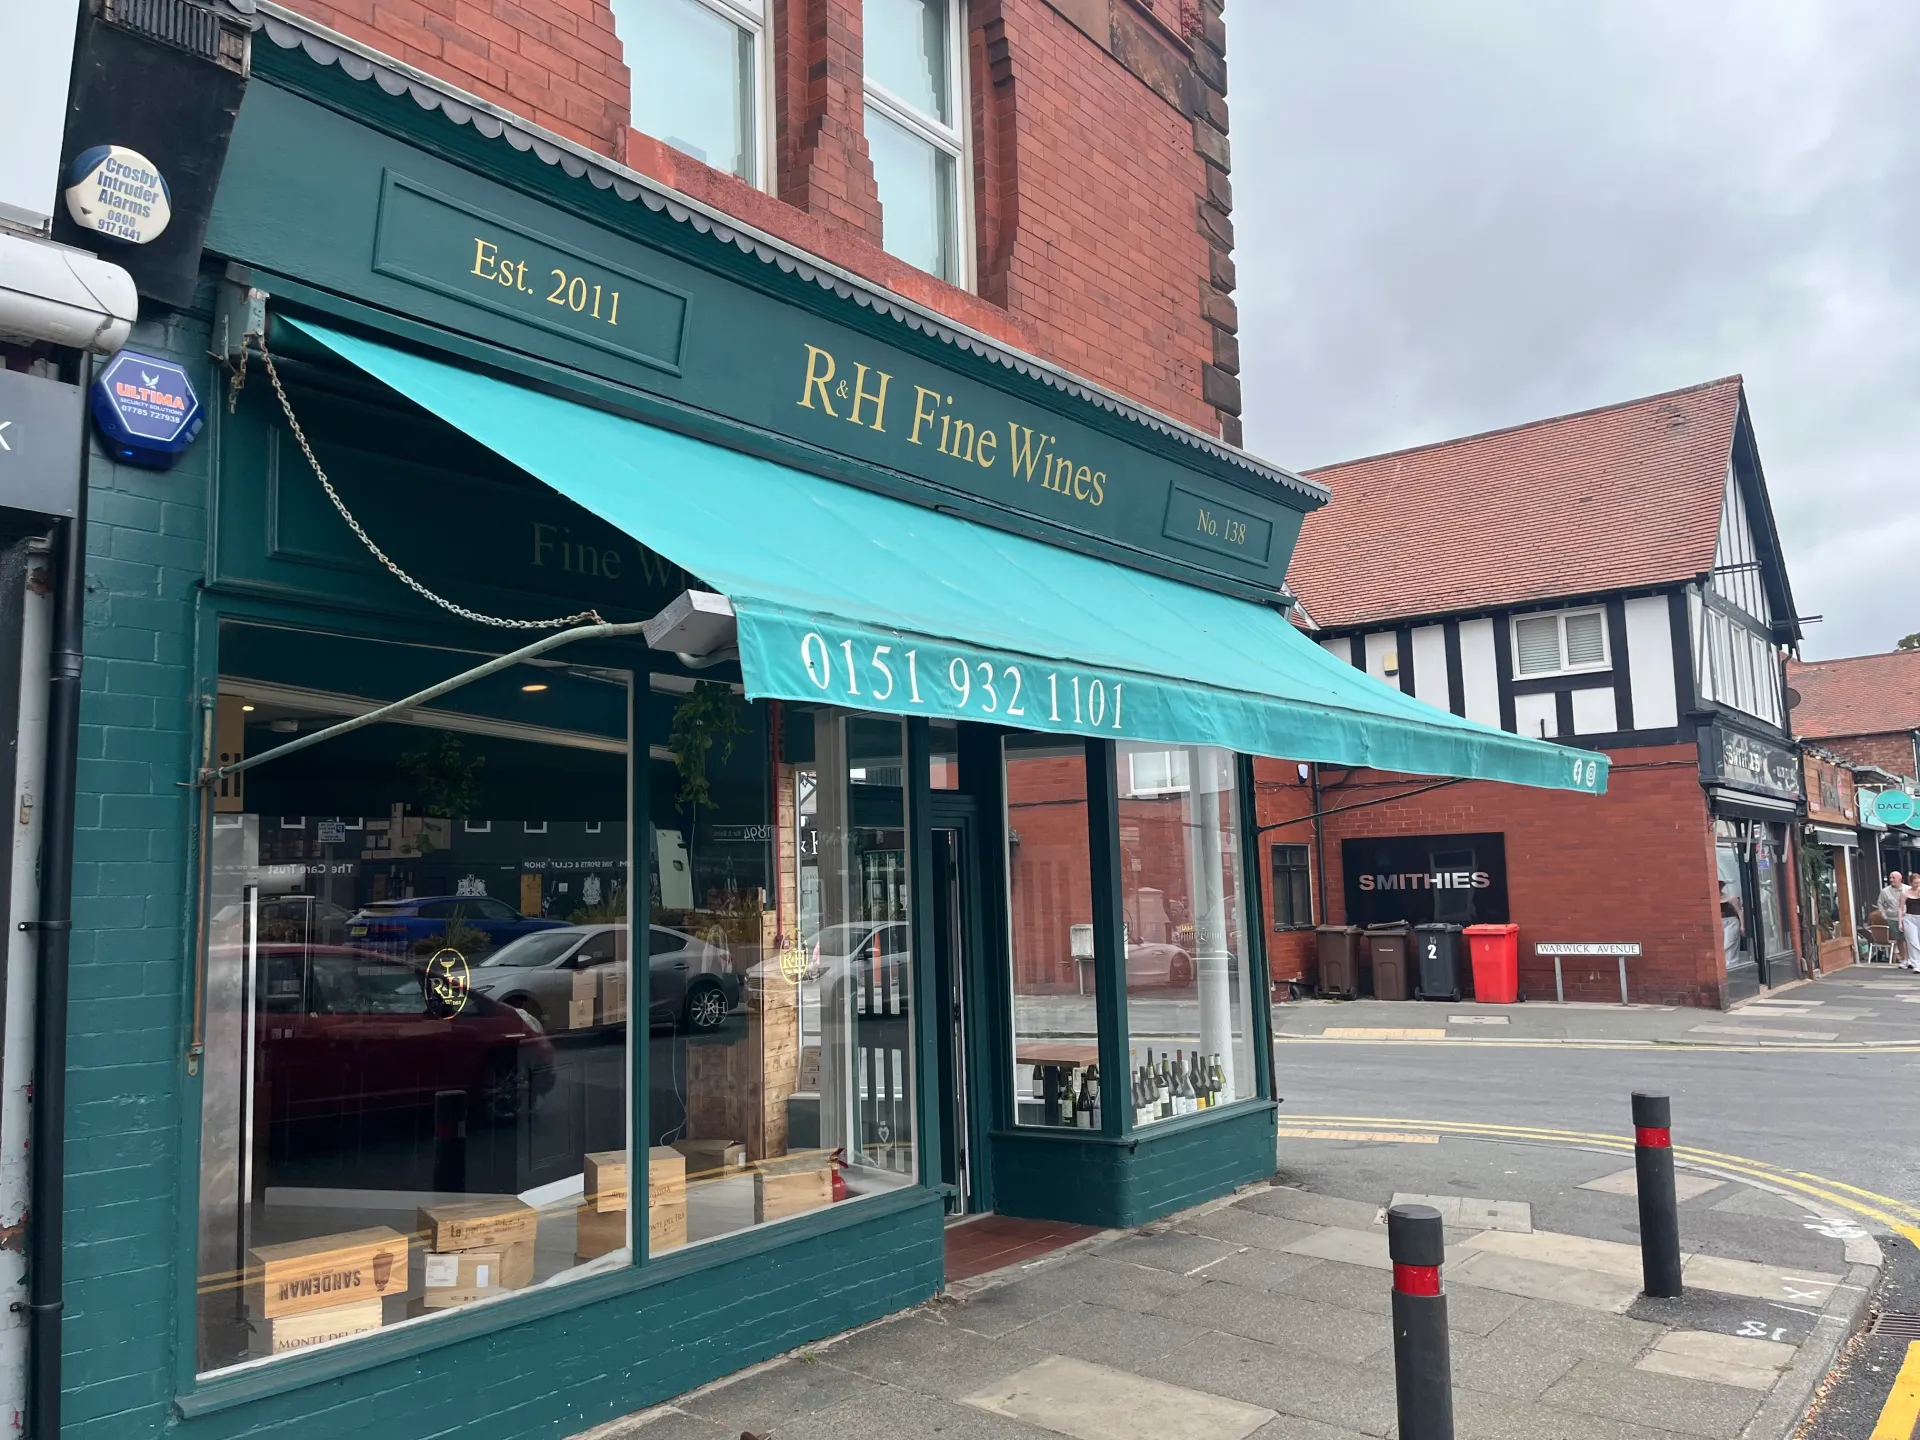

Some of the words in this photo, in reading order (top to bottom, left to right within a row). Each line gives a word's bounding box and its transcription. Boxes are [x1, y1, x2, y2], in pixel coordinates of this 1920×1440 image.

[105, 157, 158, 189] Crosby
[97, 171, 160, 204] Intruder
[98, 188, 151, 218] Alarms
[97, 218, 116, 232] 917
[117, 225, 141, 241] 1441
[107, 209, 136, 228] 0800
[470, 237, 534, 295] Est.
[546, 268, 620, 326] 2011
[116, 382, 185, 410] ULTIMA
[120, 397, 149, 408] SECURITY
[149, 404, 183, 416] SOLUTIONS
[121, 405, 148, 416] 07785
[796, 343, 894, 433] R&H
[906, 384, 997, 469] Fine
[1008, 421, 1107, 506] Wines
[1197, 508, 1219, 537] No.
[1223, 519, 1246, 545] 138
[529, 521, 622, 580] Fine
[800, 632, 925, 704] 0151
[949, 657, 1025, 717] 932
[1047, 672, 1123, 729] 1101
[1877, 802, 1911, 810] DACE
[1358, 871, 1491, 891] SMITHIES
[1427, 944, 1437, 959] 2
[1540, 944, 1590, 953] WARWICK
[1596, 944, 1638, 953] AVENUE
[279, 1269, 362, 1301] SANDEMAN
[278, 1335, 325, 1350] MONTE
